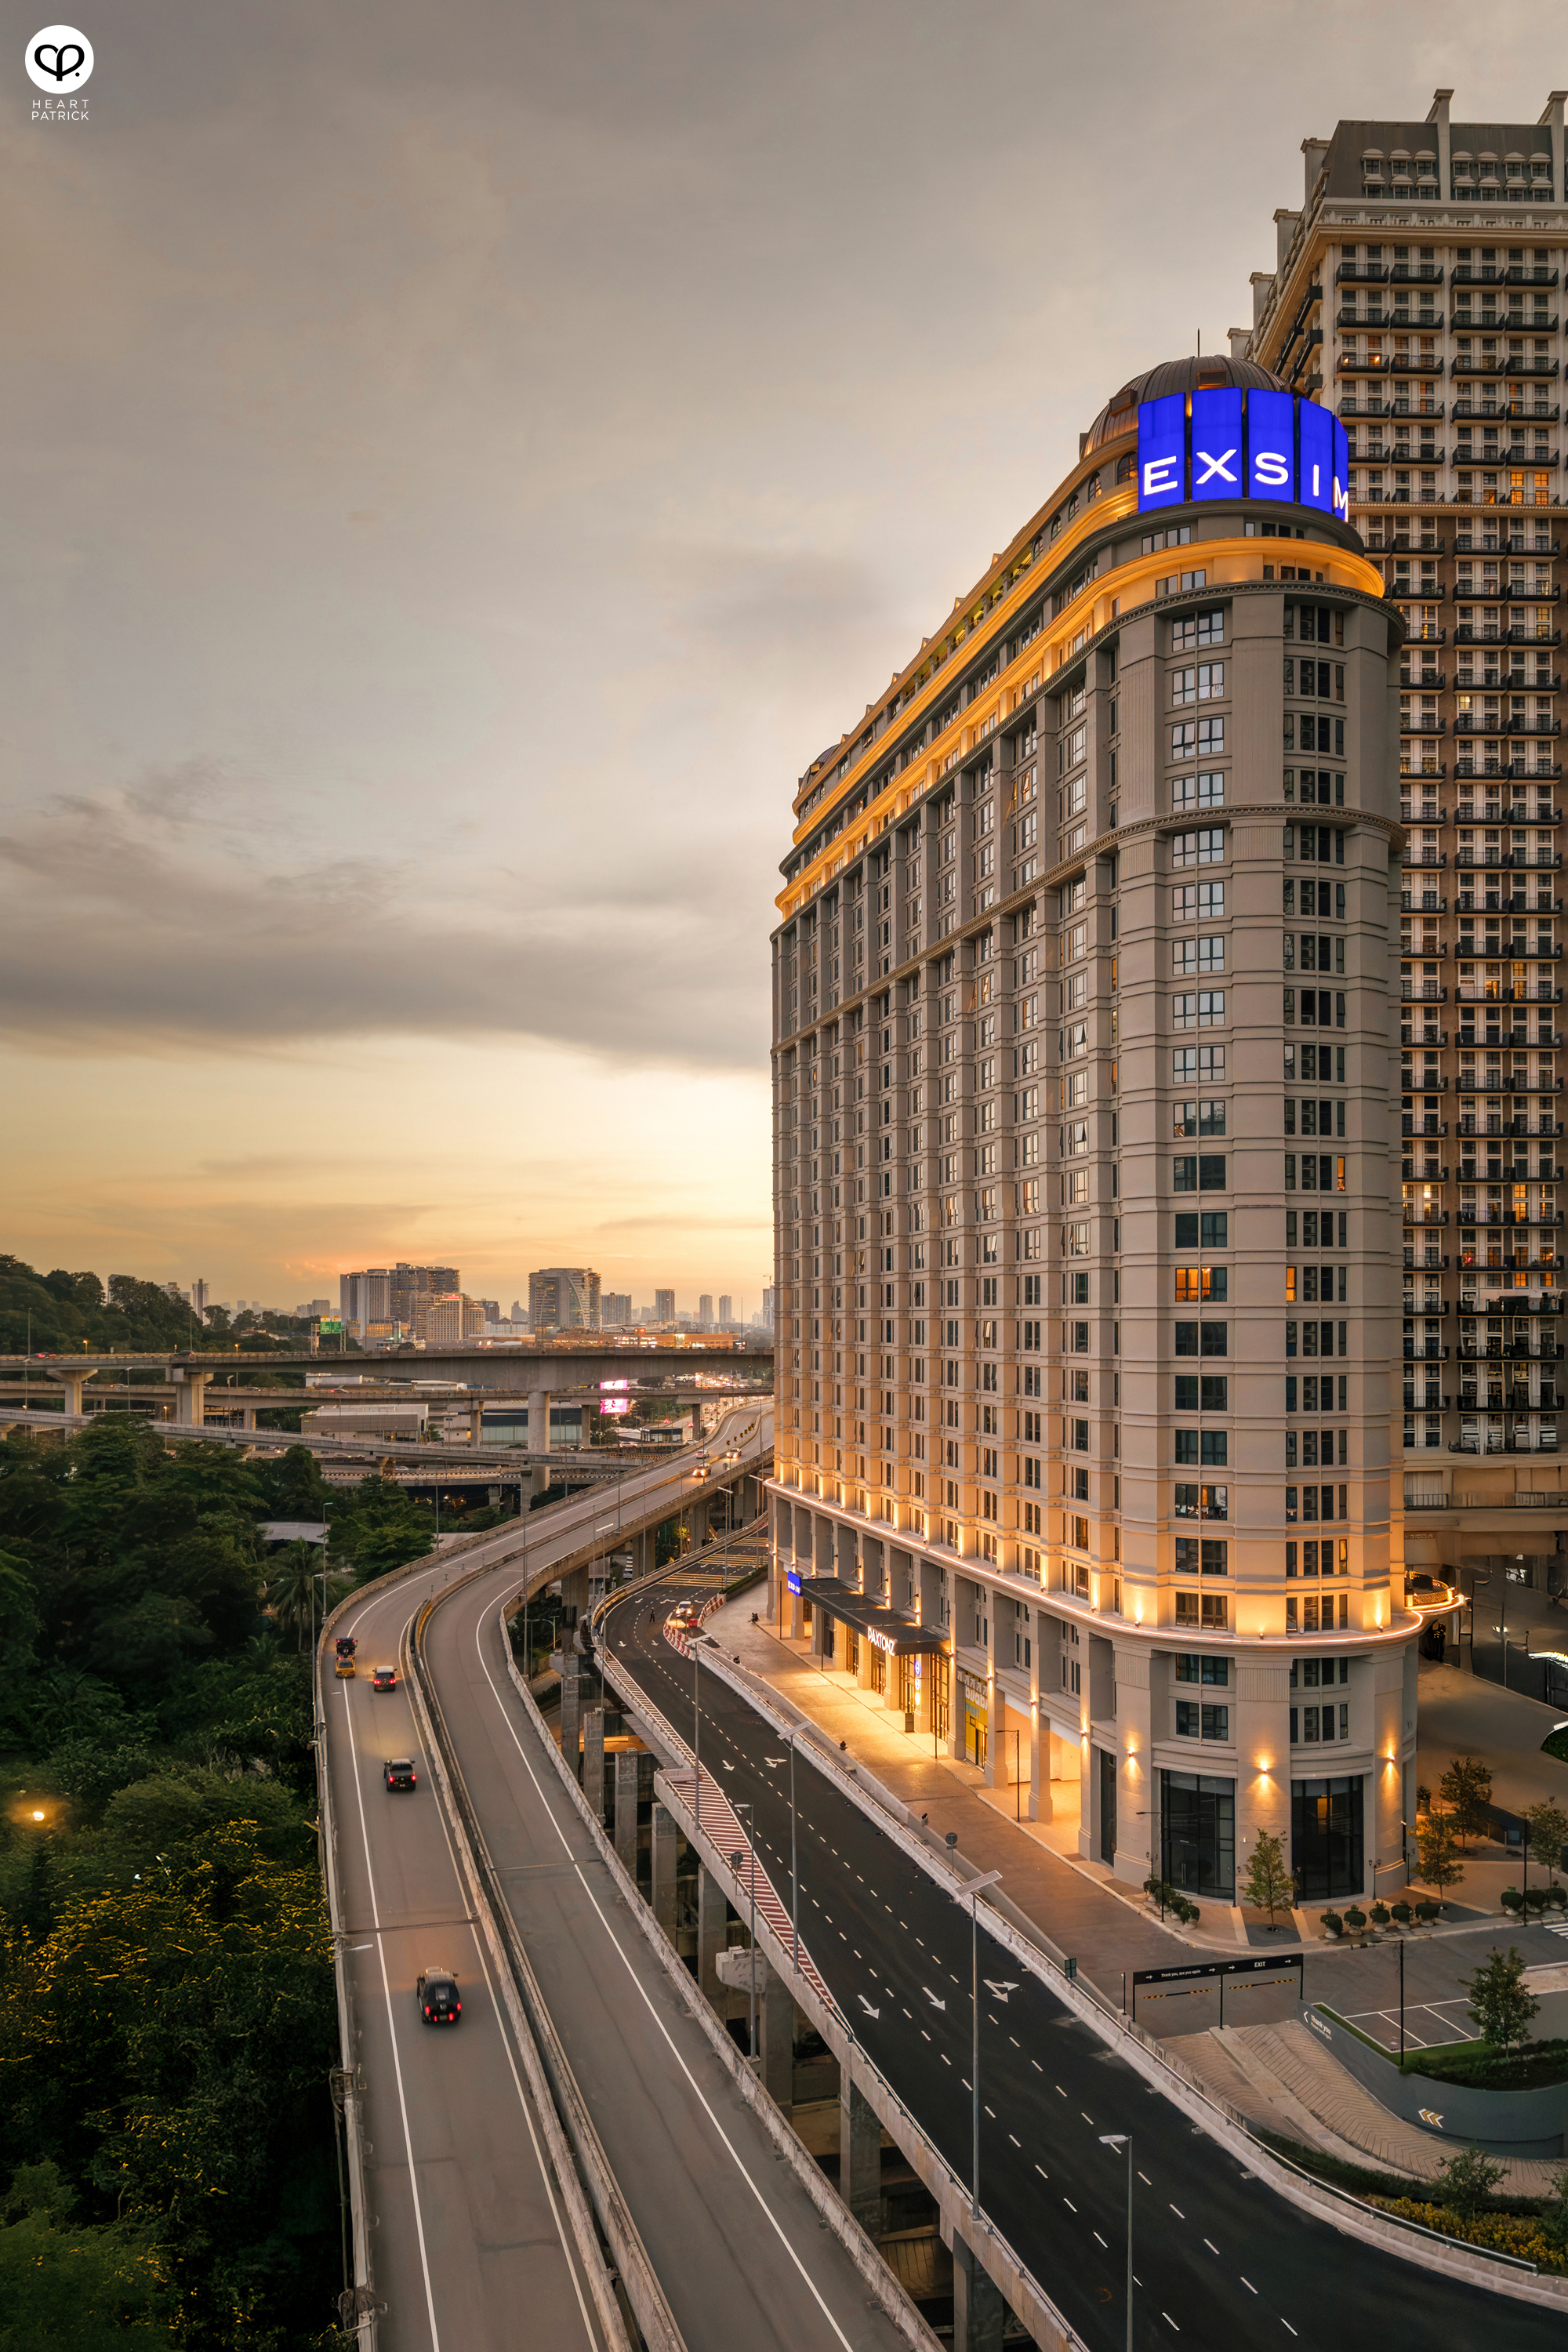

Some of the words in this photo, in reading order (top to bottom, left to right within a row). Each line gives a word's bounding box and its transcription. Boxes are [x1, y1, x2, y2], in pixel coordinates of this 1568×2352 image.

[1143, 448, 1348, 522] EXSIM
[867, 1626, 895, 1657] PAXTONZ
[1311, 2014, 1323, 2029] Thank
[1323, 2024, 1331, 2035] you
